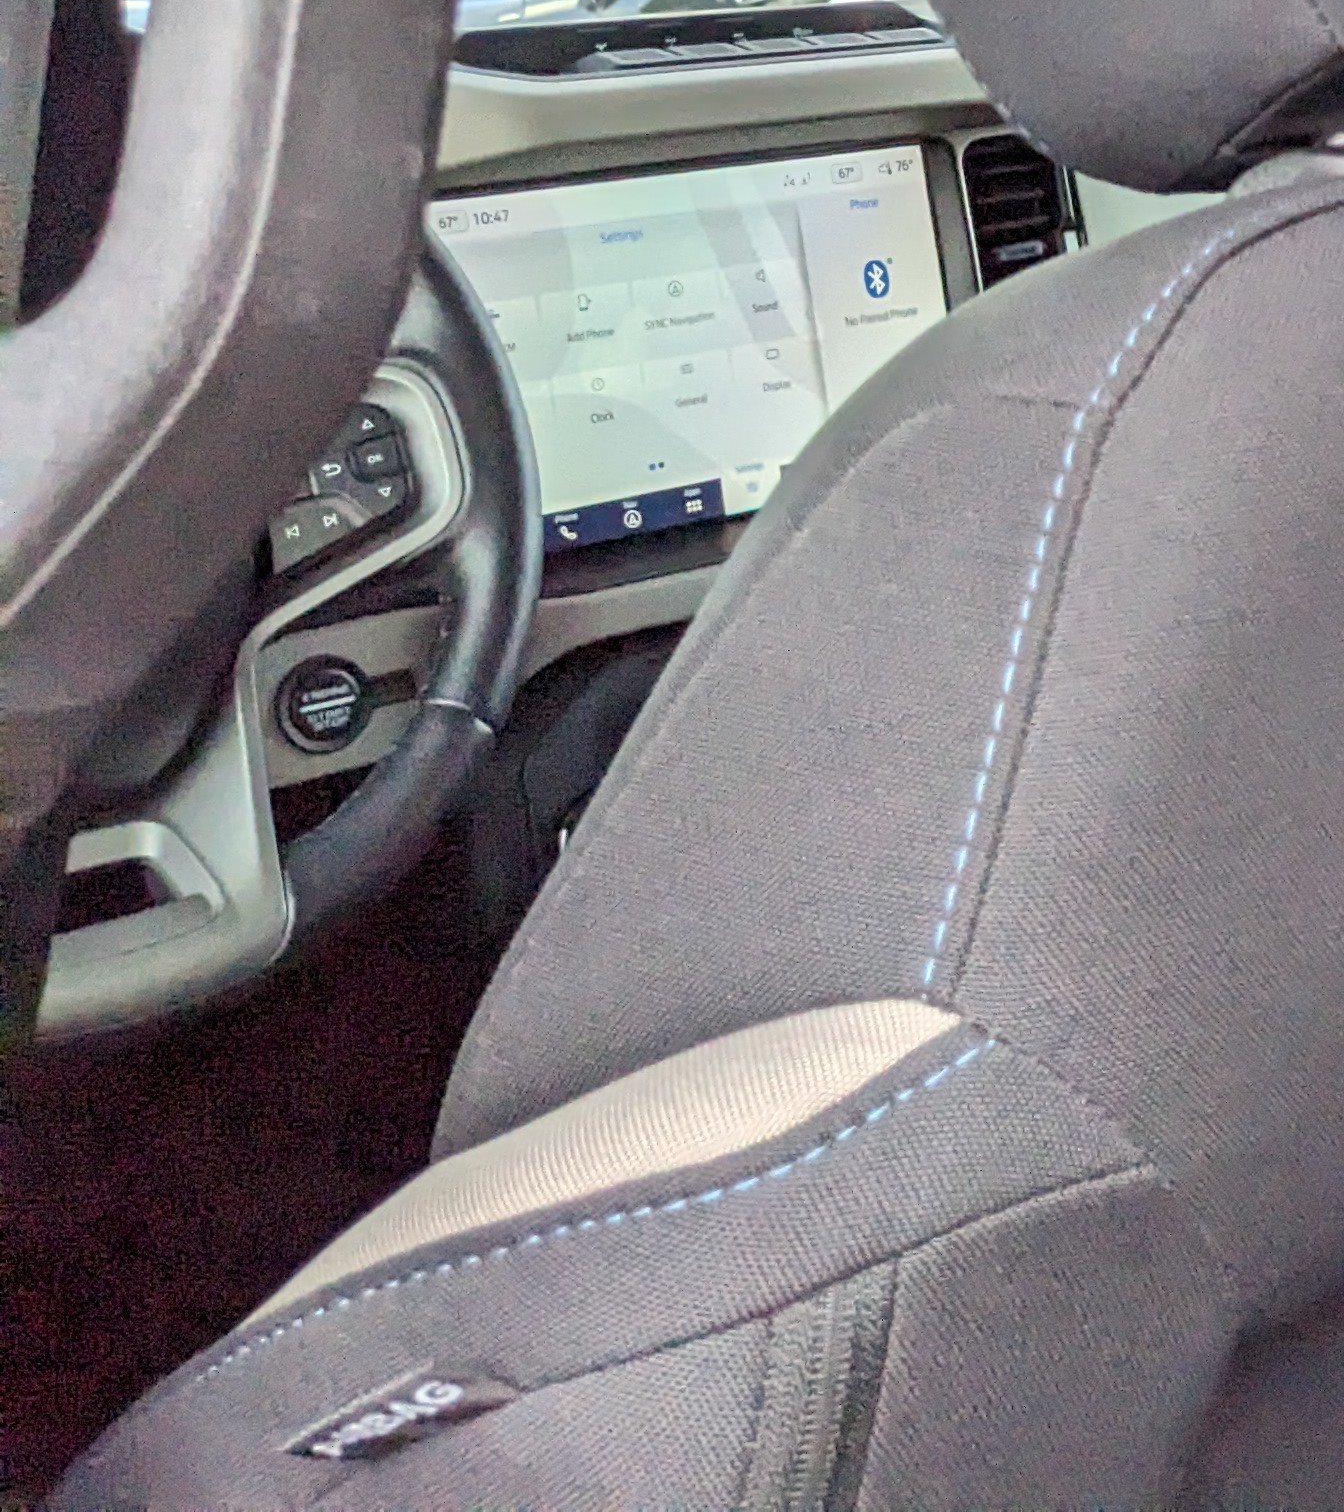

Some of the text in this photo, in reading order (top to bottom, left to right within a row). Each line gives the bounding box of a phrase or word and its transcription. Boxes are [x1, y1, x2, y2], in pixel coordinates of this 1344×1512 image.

[850, 198, 879, 209] Phone
[473, 209, 509, 226] 10:47
[601, 229, 644, 243] Settings
[586, 328, 616, 340] Phone
[591, 409, 615, 424] Clock
